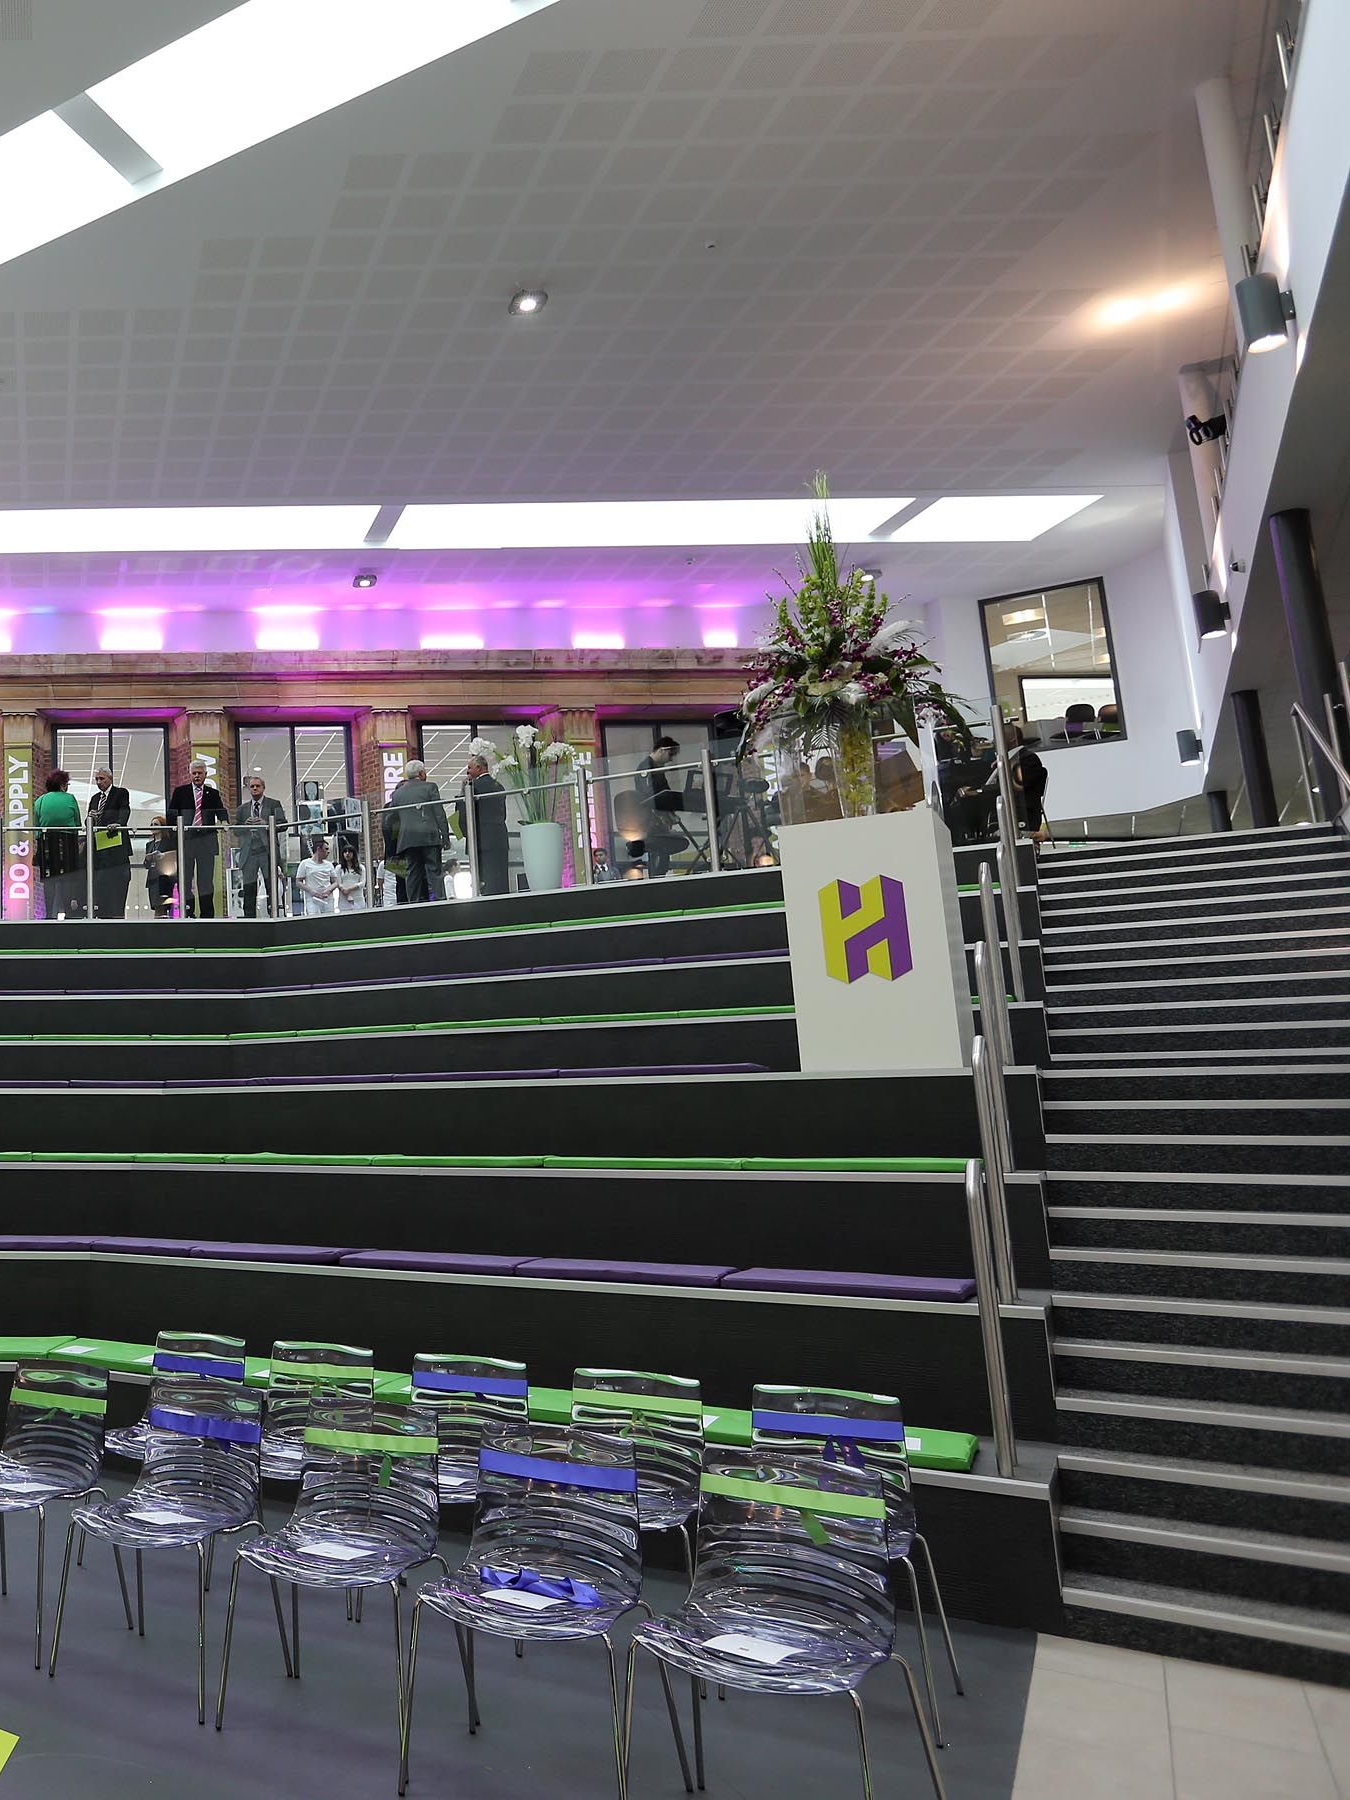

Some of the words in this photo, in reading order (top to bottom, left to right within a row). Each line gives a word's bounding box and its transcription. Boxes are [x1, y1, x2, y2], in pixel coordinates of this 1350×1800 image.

[8, 755, 30, 835] APPLY
[8, 840, 30, 857] &
[8, 863, 30, 900] DO
